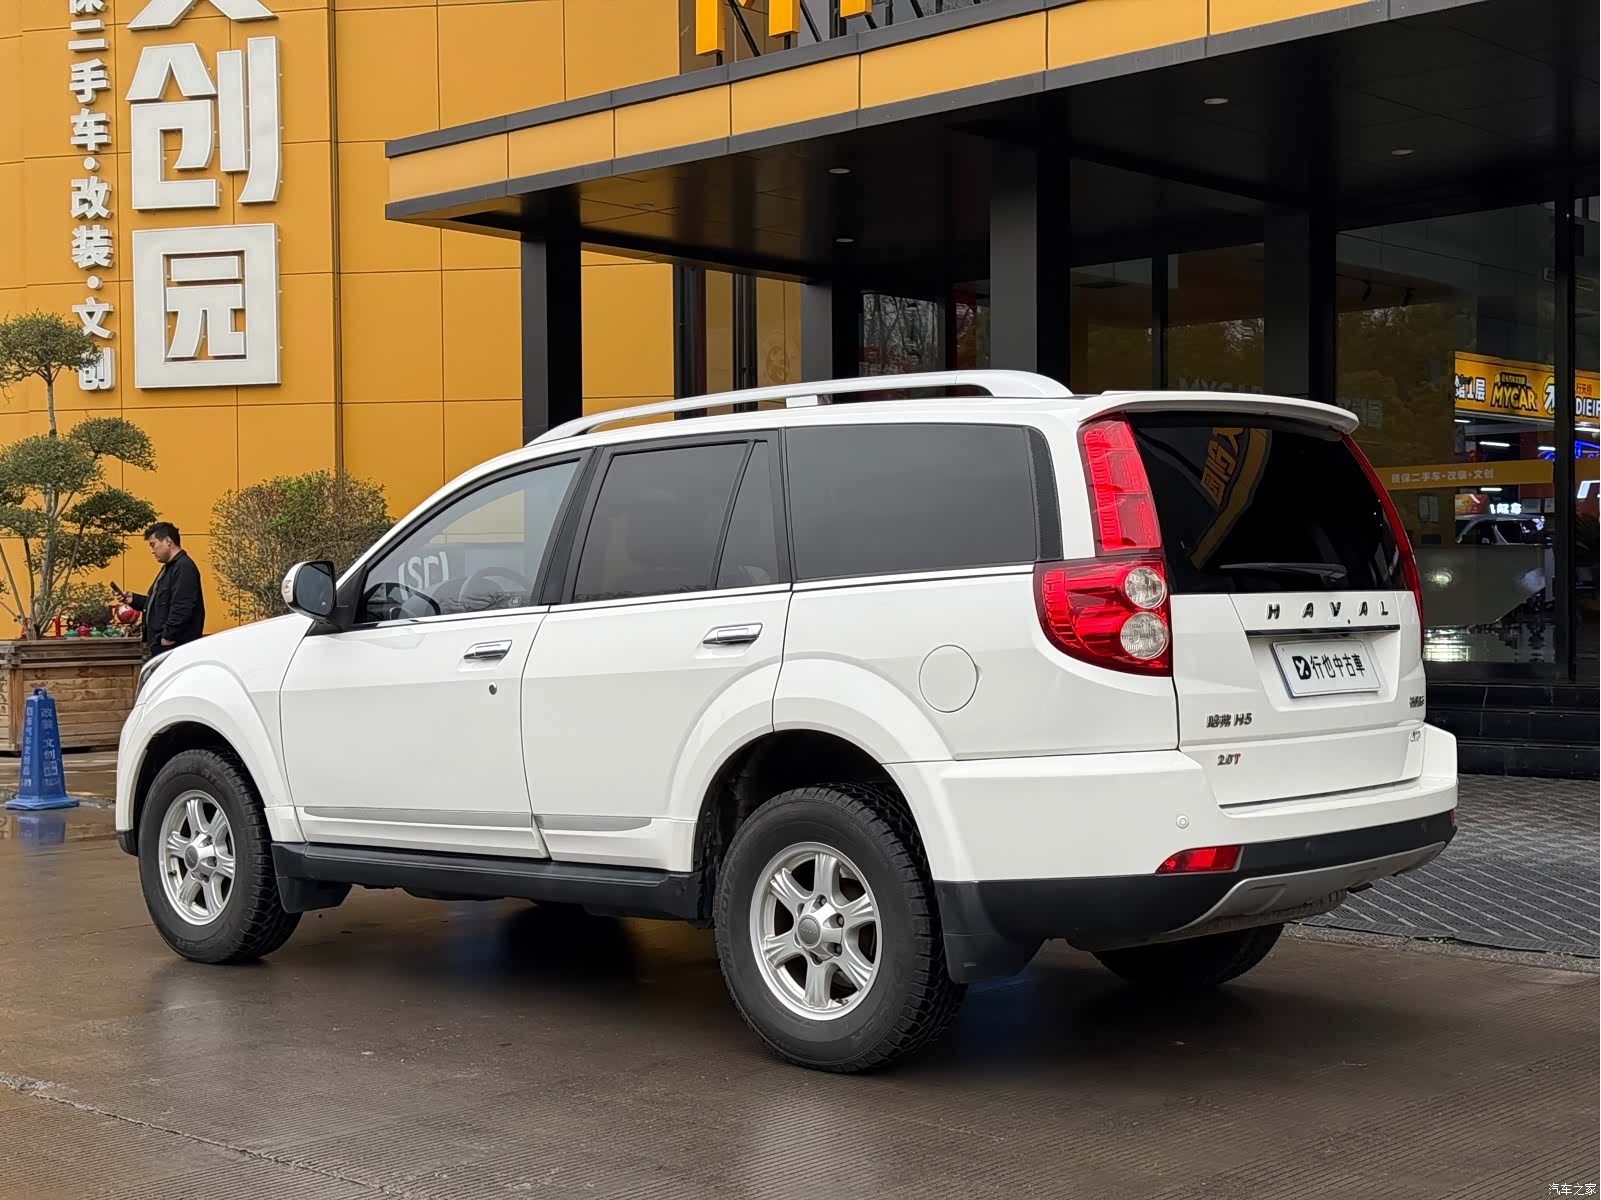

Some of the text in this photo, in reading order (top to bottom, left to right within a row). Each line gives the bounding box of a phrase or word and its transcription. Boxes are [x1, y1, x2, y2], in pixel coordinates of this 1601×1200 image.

[1491, 384, 1538, 411] MYCAR
[1266, 601, 1389, 620] HAVAL
[1310, 653, 1366, 680] 行也中古車
[1233, 712, 1253, 727] H5
